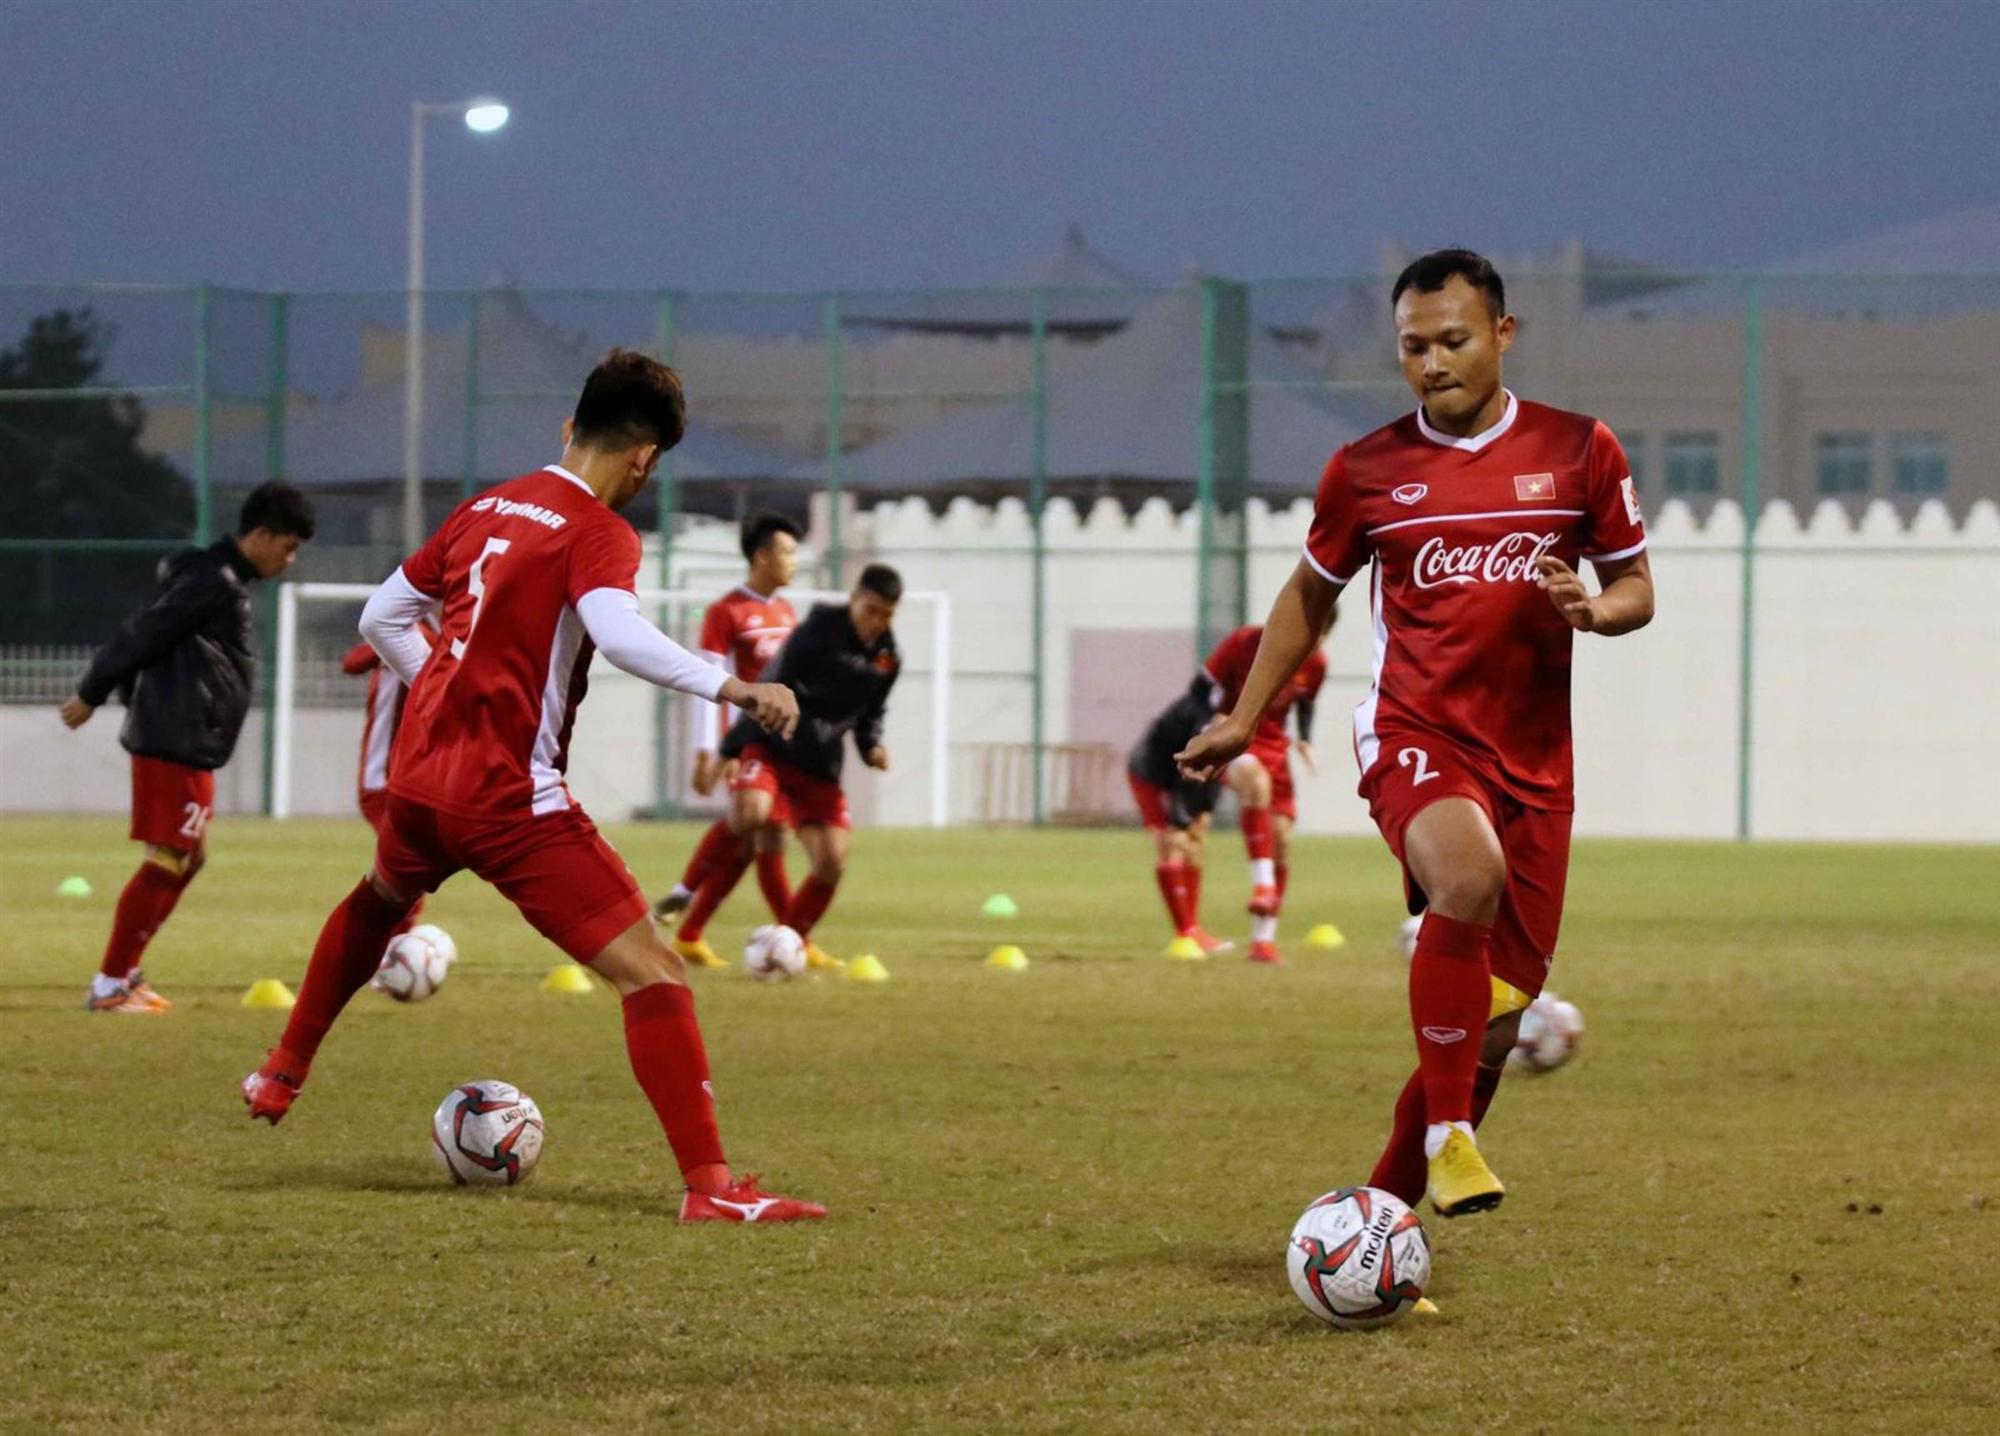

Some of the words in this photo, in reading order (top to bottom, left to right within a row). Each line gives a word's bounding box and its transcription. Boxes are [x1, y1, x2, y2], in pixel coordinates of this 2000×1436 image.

[450, 536, 511, 661] 5
[1398, 747, 1440, 787] 2
[1360, 1207, 1394, 1270] molten
